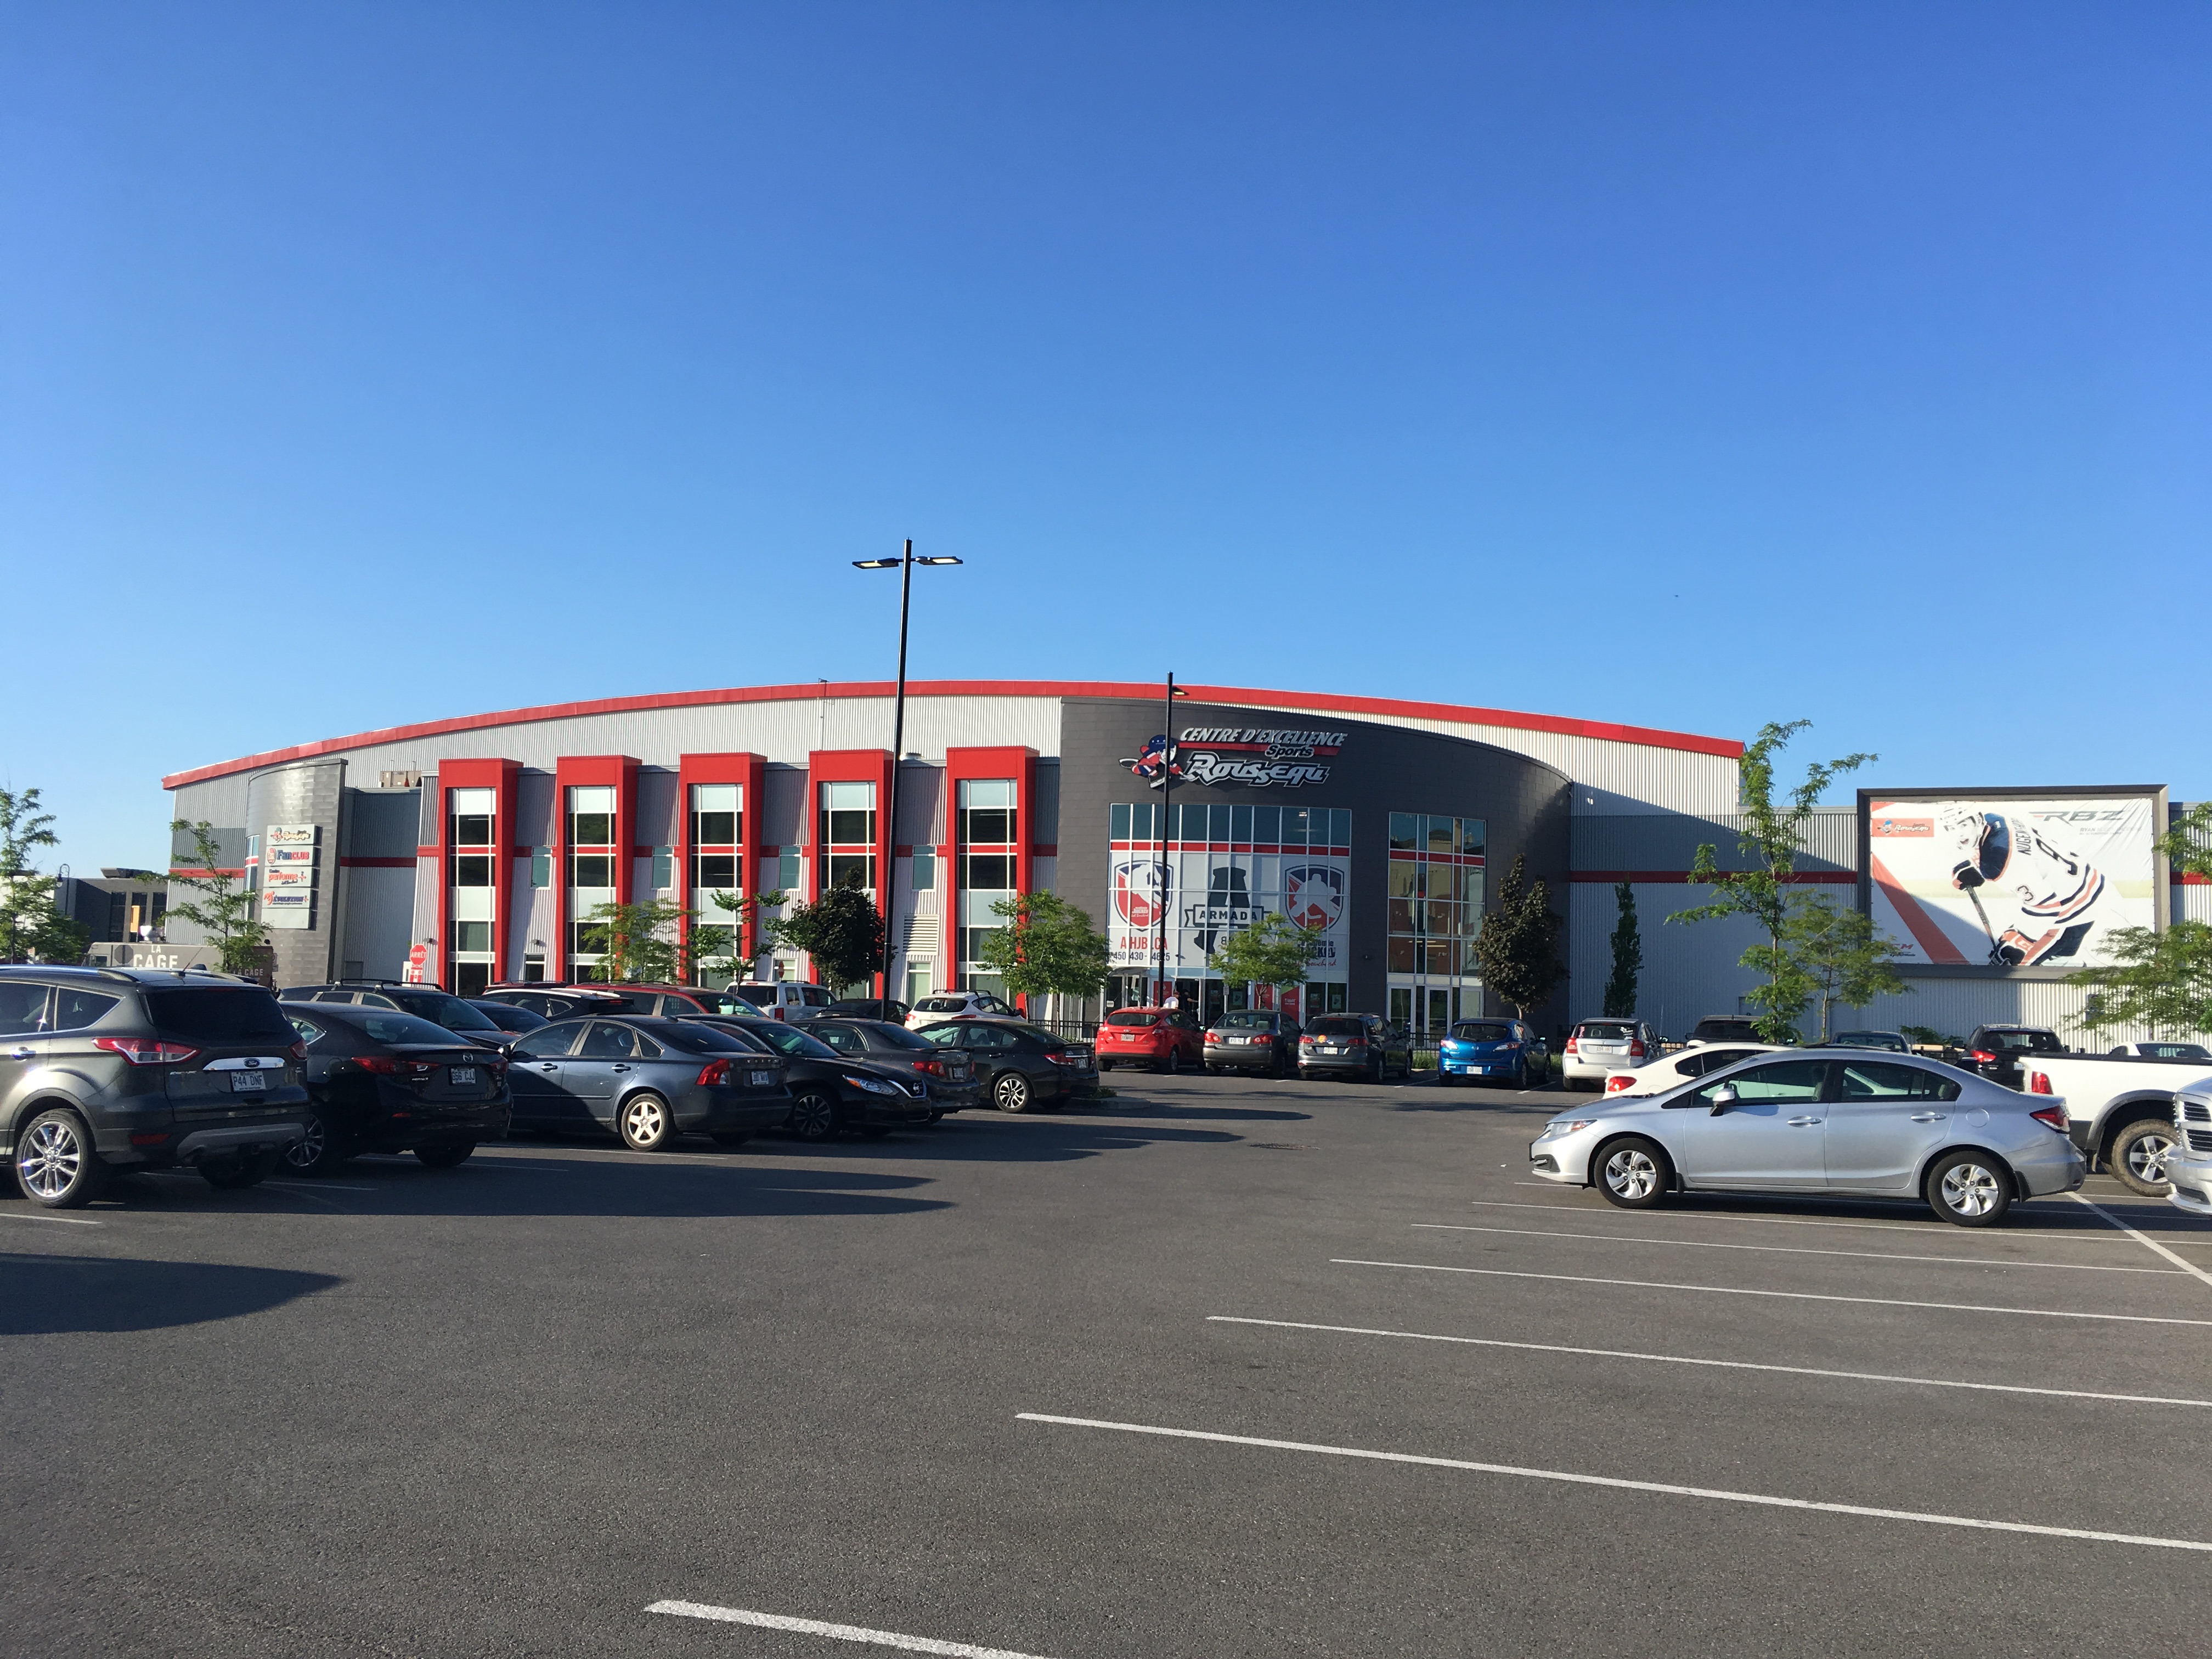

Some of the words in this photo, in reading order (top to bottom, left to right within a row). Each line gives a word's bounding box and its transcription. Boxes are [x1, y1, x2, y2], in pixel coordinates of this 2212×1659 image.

[1180, 727, 1242, 742] CENTRE
[1240, 729, 1348, 747] D'EXCELLENCE
[1265, 744, 1314, 759] Sports
[2029, 811, 2126, 827] RBZ
[1199, 910, 1258, 920] ARMADA
[151, 945, 161, 953] LA
[410, 950, 427, 958] ARRÊT
[233, 1076, 247, 1086] P44
[250, 1075, 263, 1085] DNF
